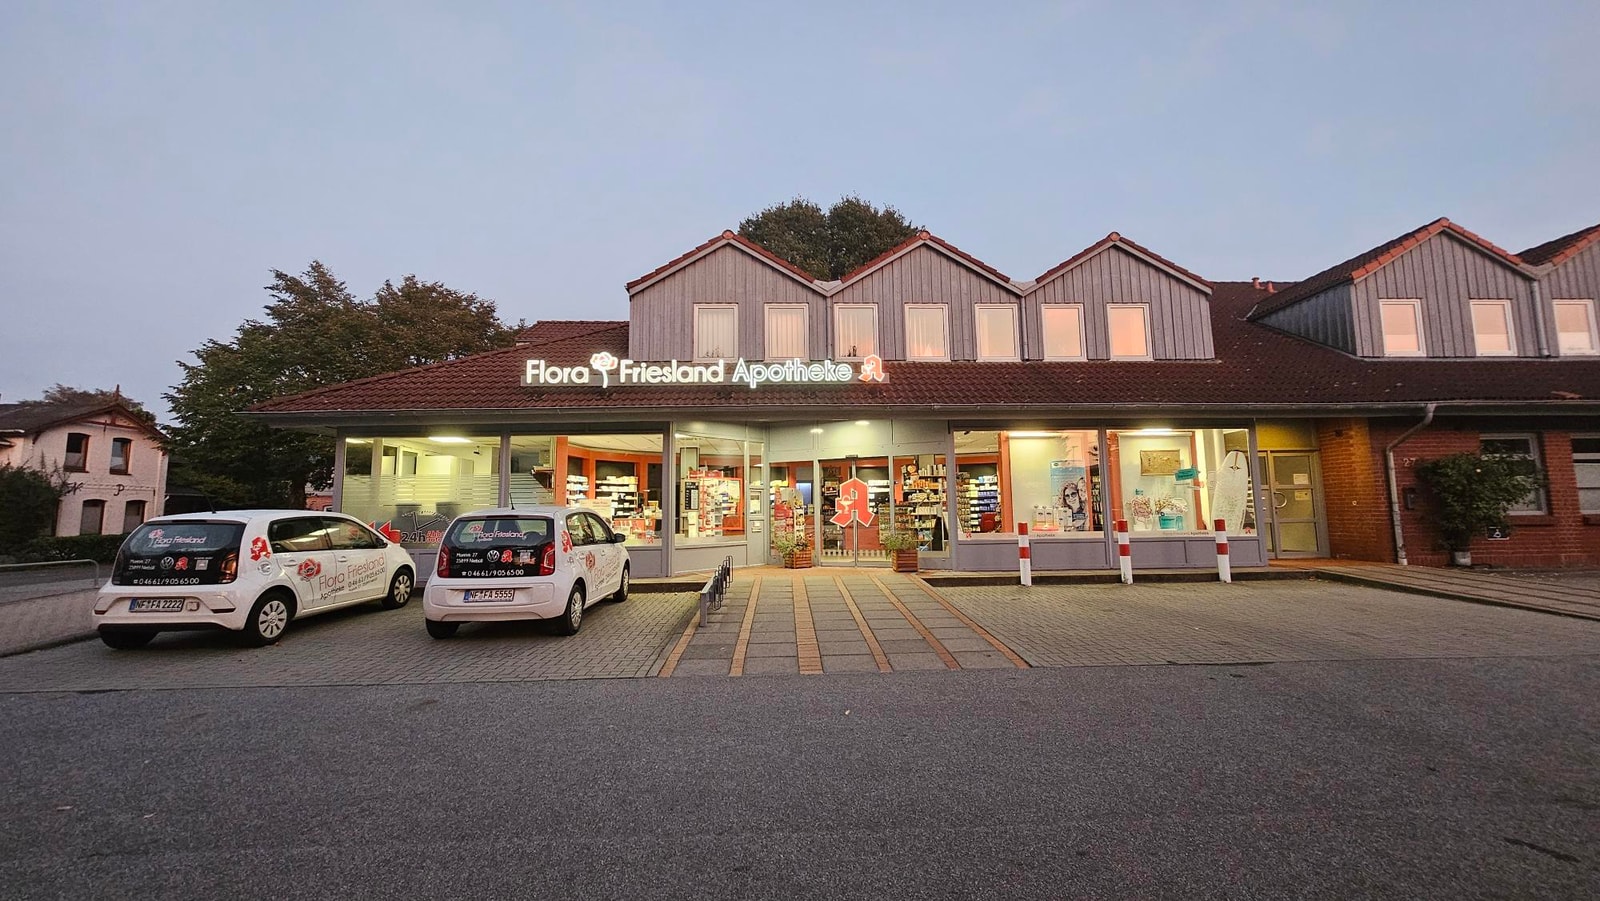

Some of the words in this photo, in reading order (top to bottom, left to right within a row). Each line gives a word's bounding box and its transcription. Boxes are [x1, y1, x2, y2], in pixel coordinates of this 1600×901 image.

[526, 359, 589, 384] Flora
[619, 358, 724, 384] Friesland
[731, 357, 852, 389] Apotheke
[401, 531, 426, 543] 24h
[319, 573, 345, 591] Flora
[347, 553, 385, 579] Friesland
[483, 590, 493, 599] FA
[494, 590, 513, 599] 5555
[162, 599, 182, 609] 2222
